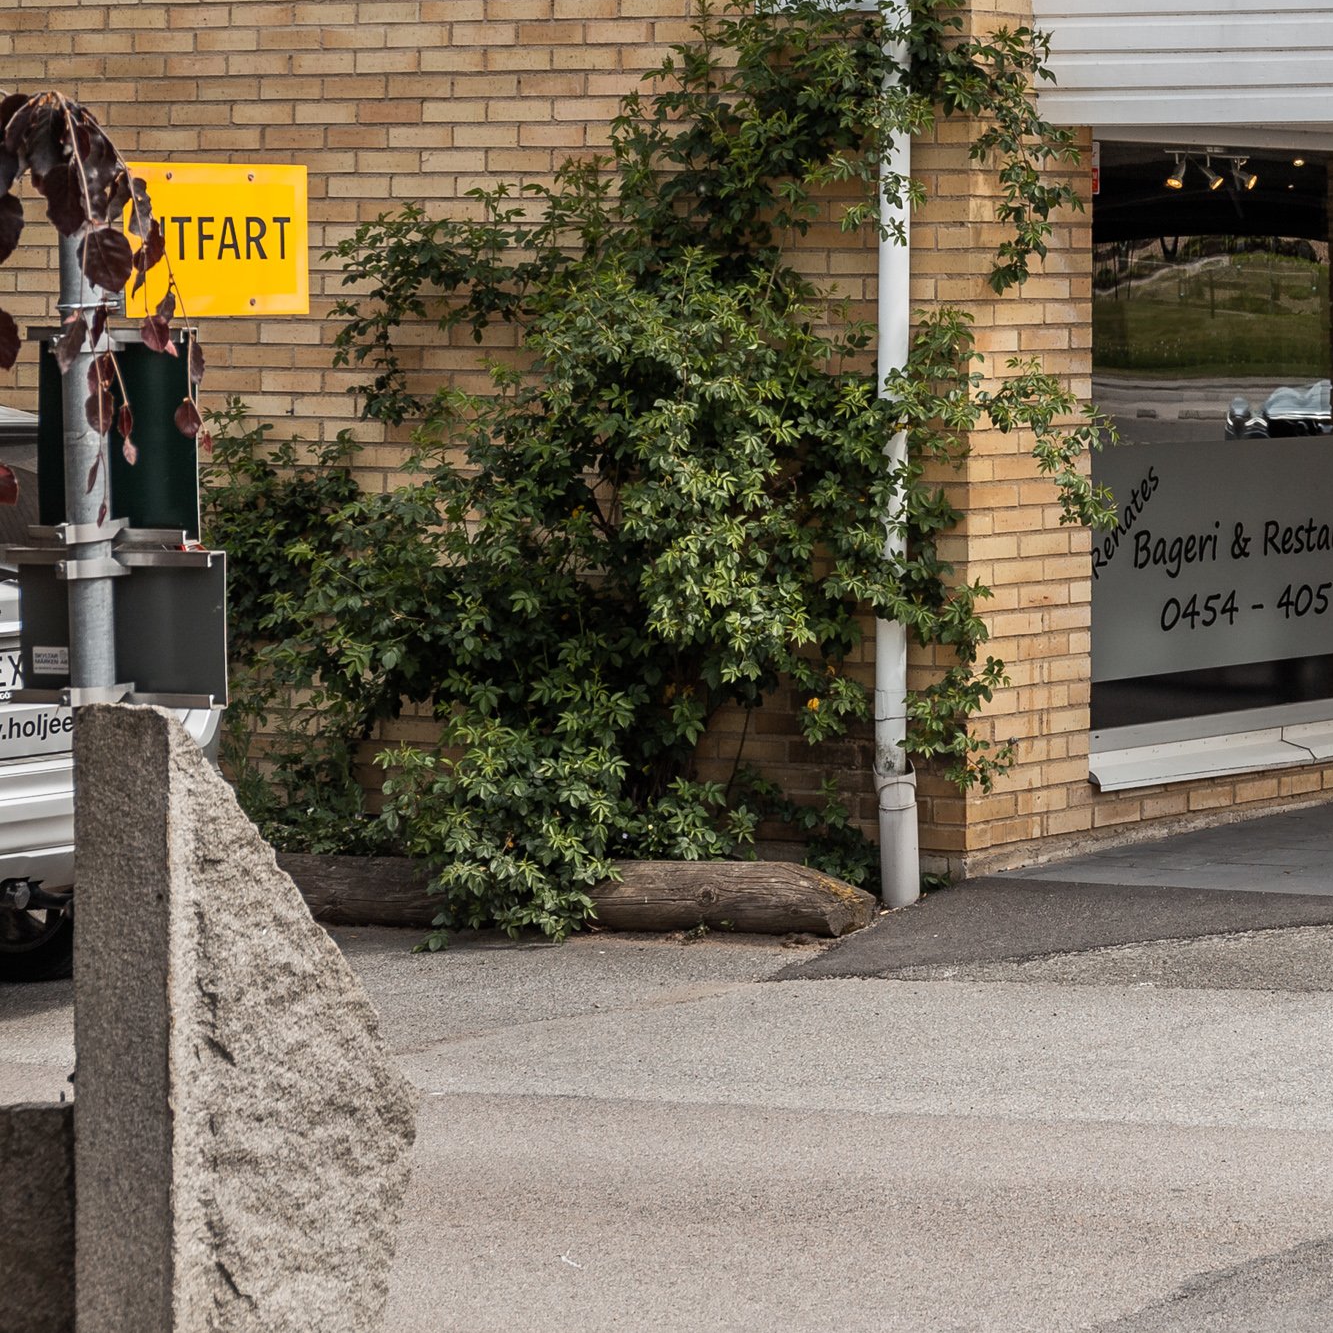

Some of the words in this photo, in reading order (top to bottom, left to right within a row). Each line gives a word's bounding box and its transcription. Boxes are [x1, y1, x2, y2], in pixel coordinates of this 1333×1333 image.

[1091, 466, 1160, 580] Renates
[1133, 521, 1220, 579] Bageri
[1230, 521, 1251, 560] &
[1160, 589, 1240, 632] 0454
[1276, 582, 1333, 619] 405
